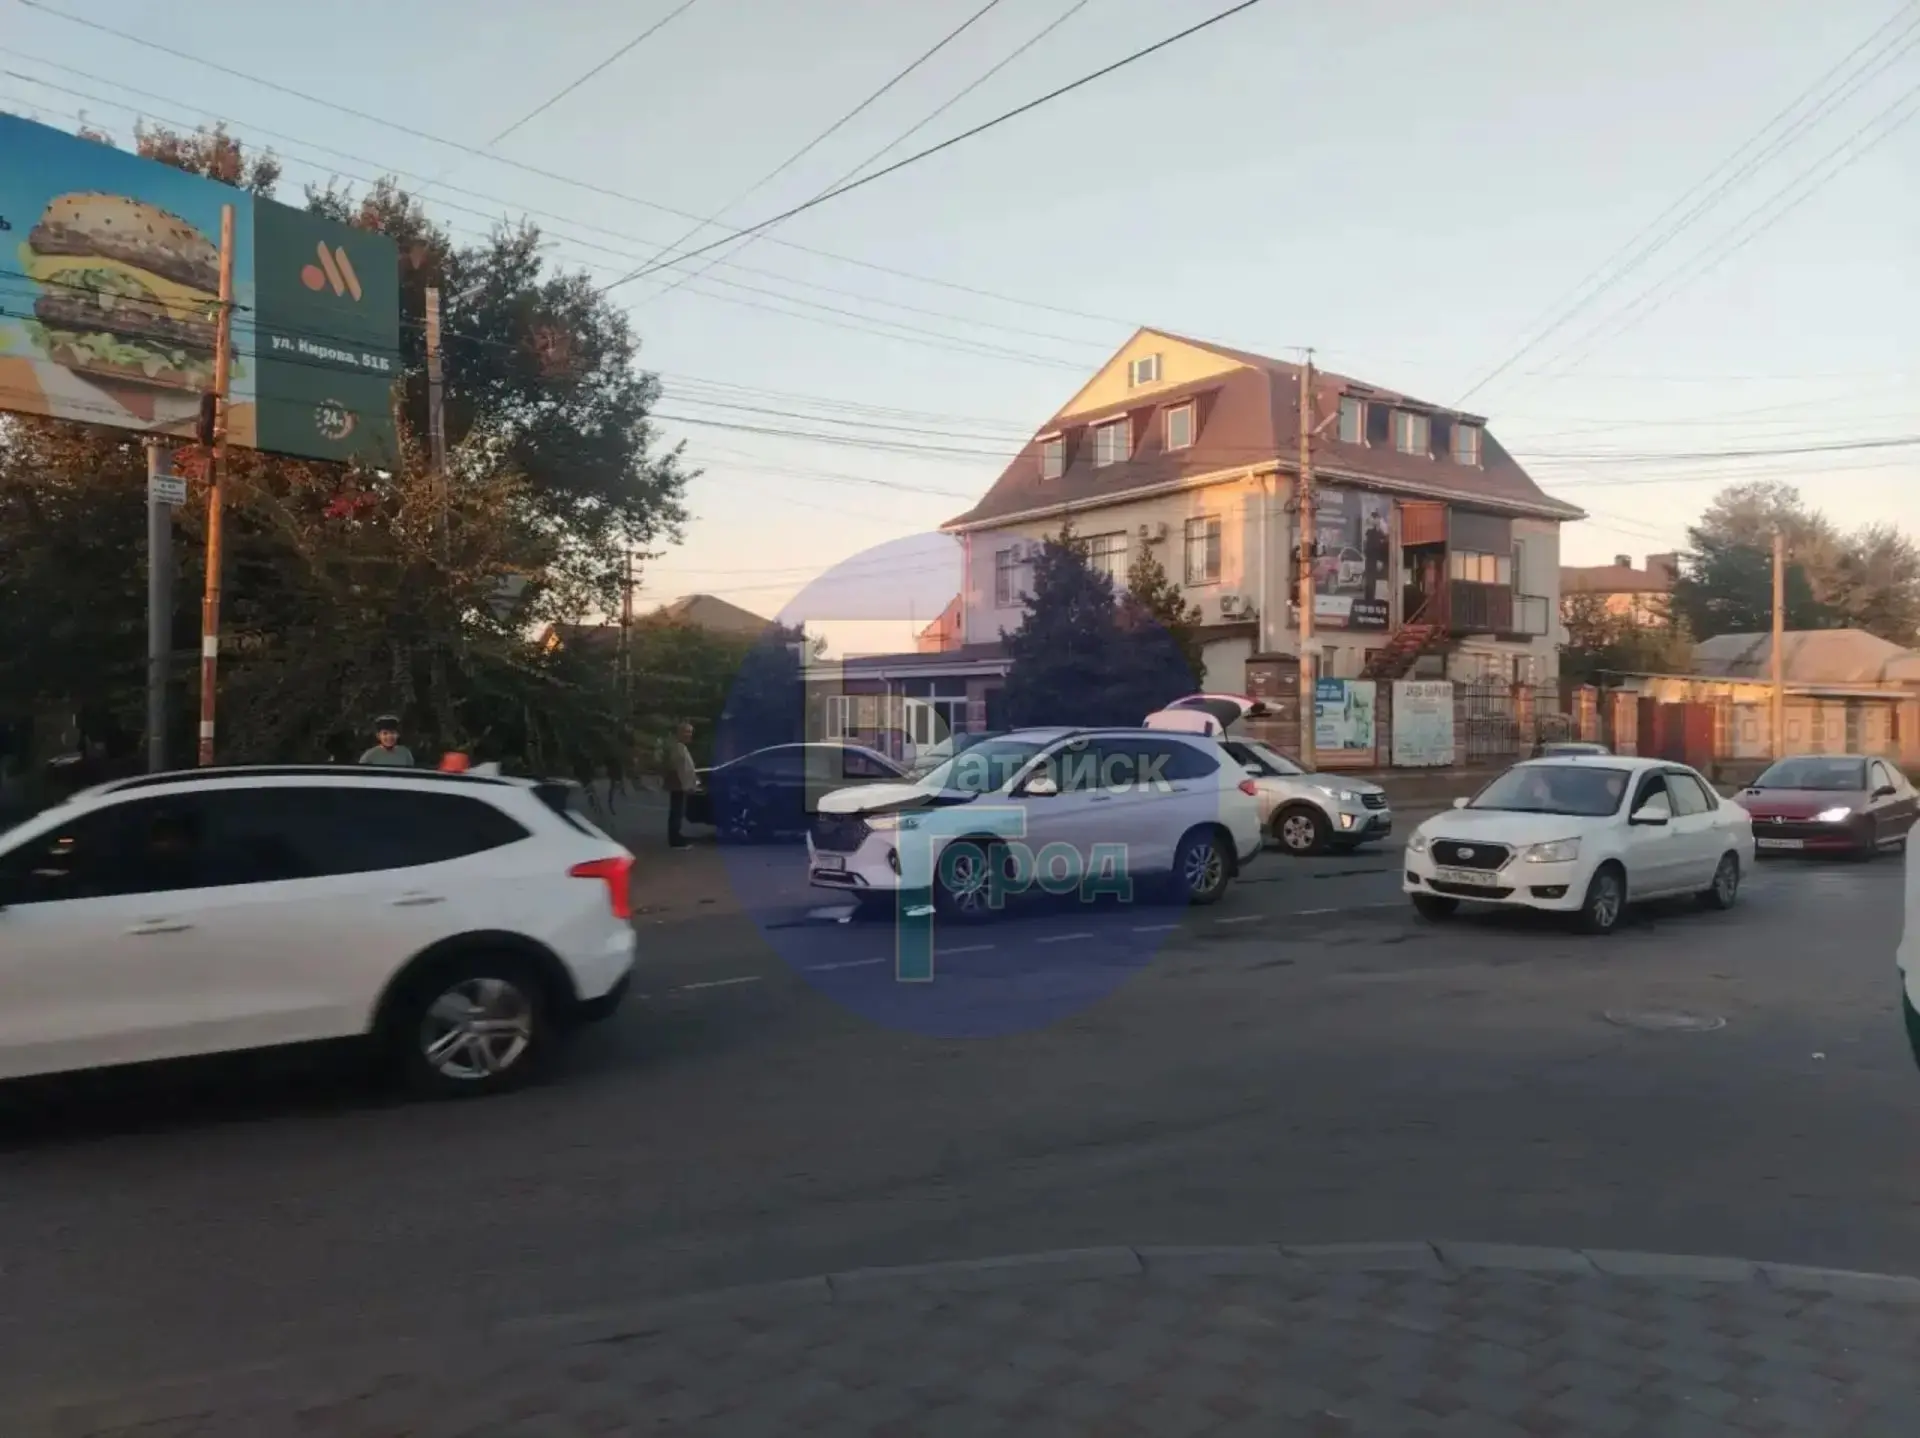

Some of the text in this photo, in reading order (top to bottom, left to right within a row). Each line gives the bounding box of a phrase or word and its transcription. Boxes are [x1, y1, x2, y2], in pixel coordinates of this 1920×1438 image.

[271, 335, 391, 371] ул. Кирова, 51Б
